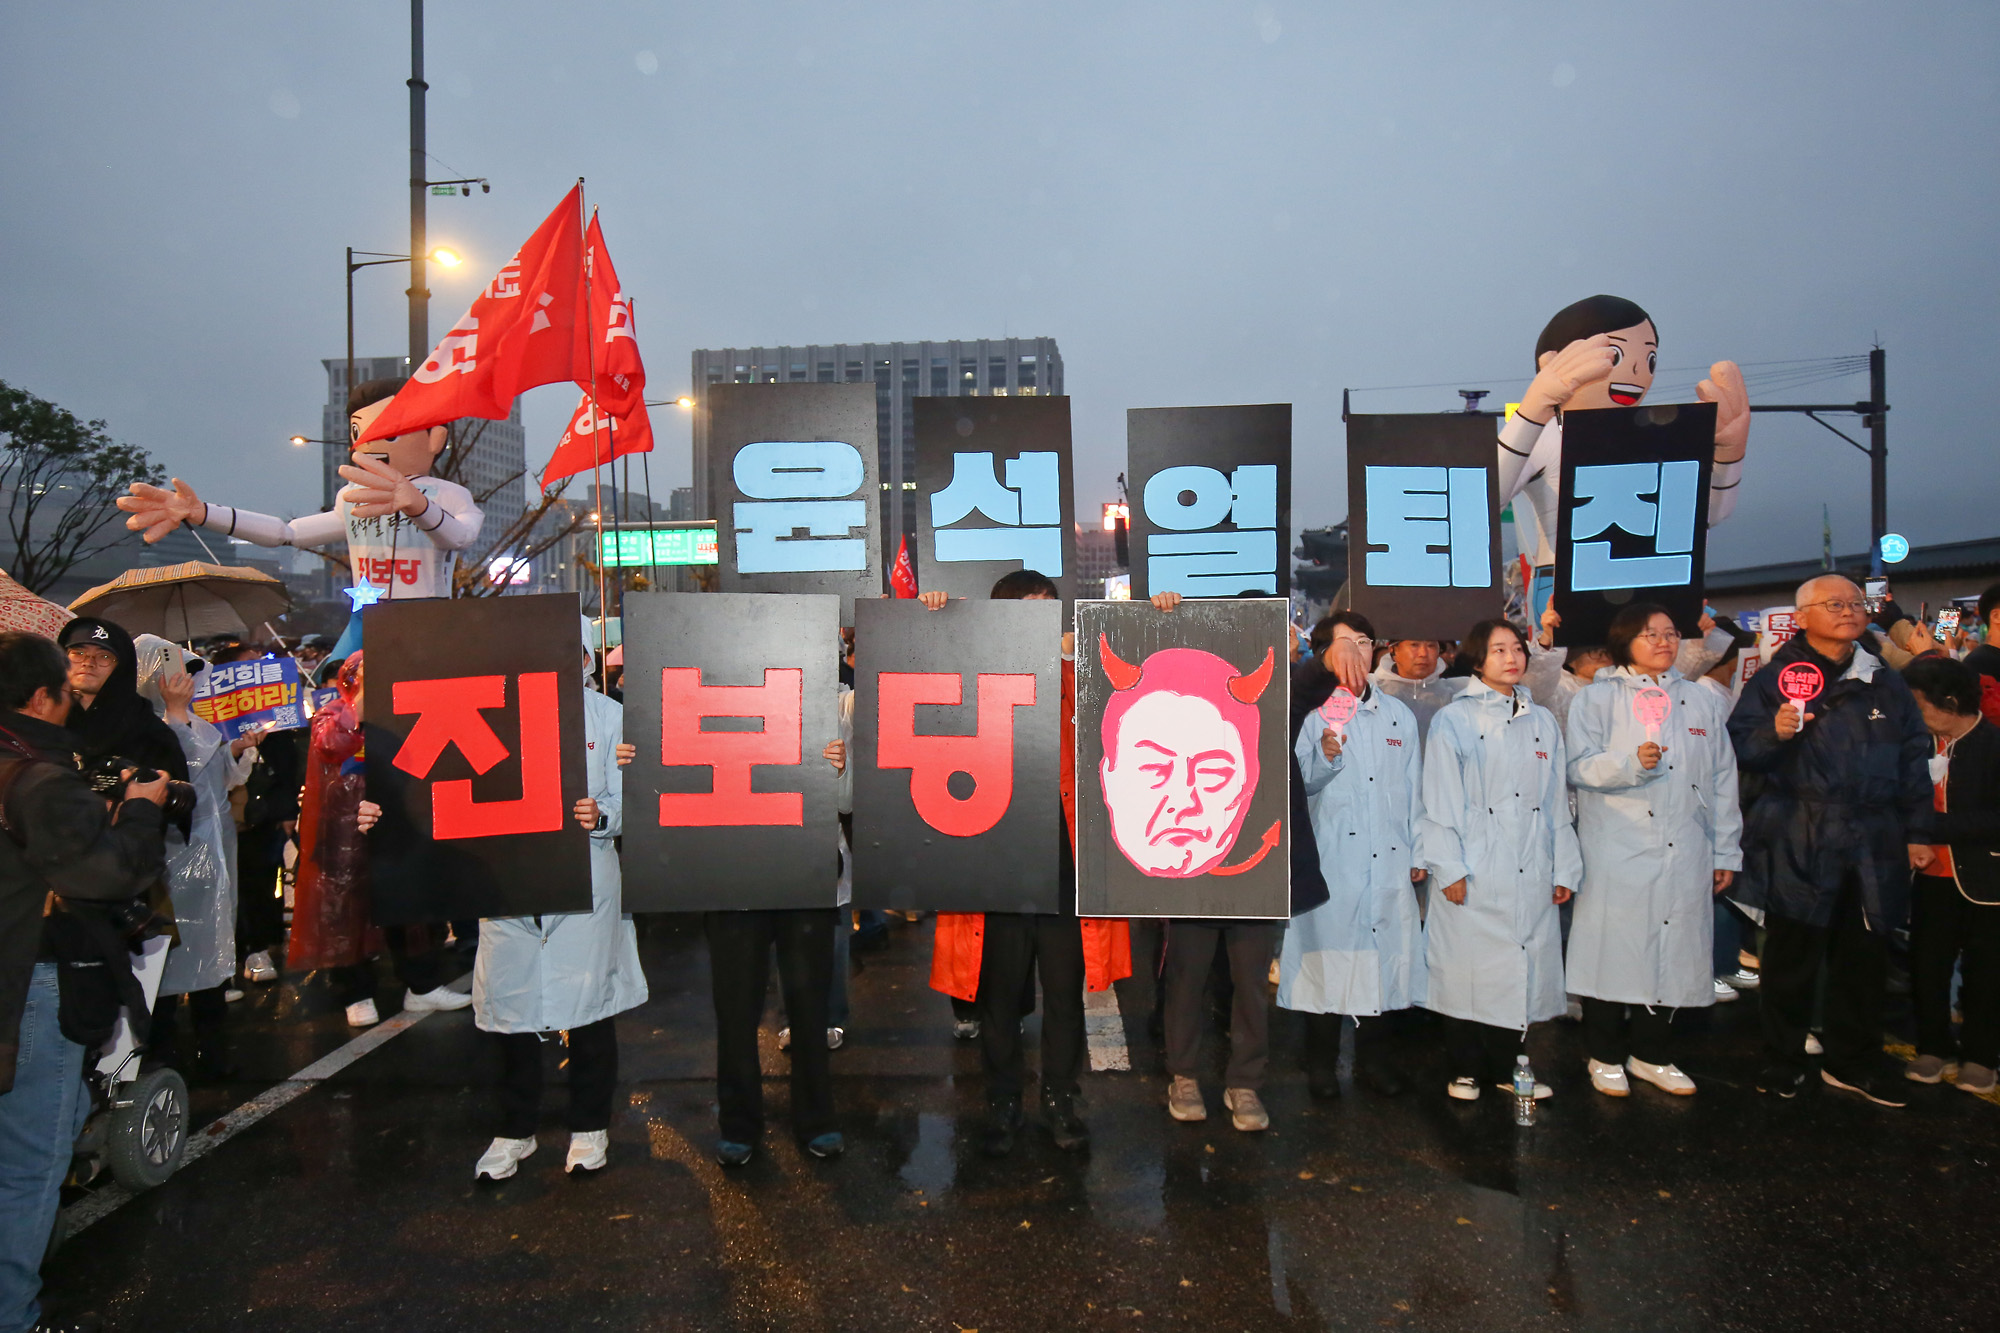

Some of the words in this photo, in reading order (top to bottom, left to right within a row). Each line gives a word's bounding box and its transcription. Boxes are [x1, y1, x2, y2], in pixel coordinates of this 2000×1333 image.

[351, 516, 384, 538] 윤석열
[733, 442, 865, 572] 윤
[930, 452, 1062, 577] 석
[1144, 465, 1277, 597] 열
[1365, 466, 1491, 587] 퇴
[1571, 461, 1699, 591] 진
[191, 682, 298, 723] 특검하라!
[1784, 670, 1819, 685] 윤석열
[392, 672, 563, 840] 진
[659, 668, 803, 827] 보
[877, 672, 1036, 837] 당
